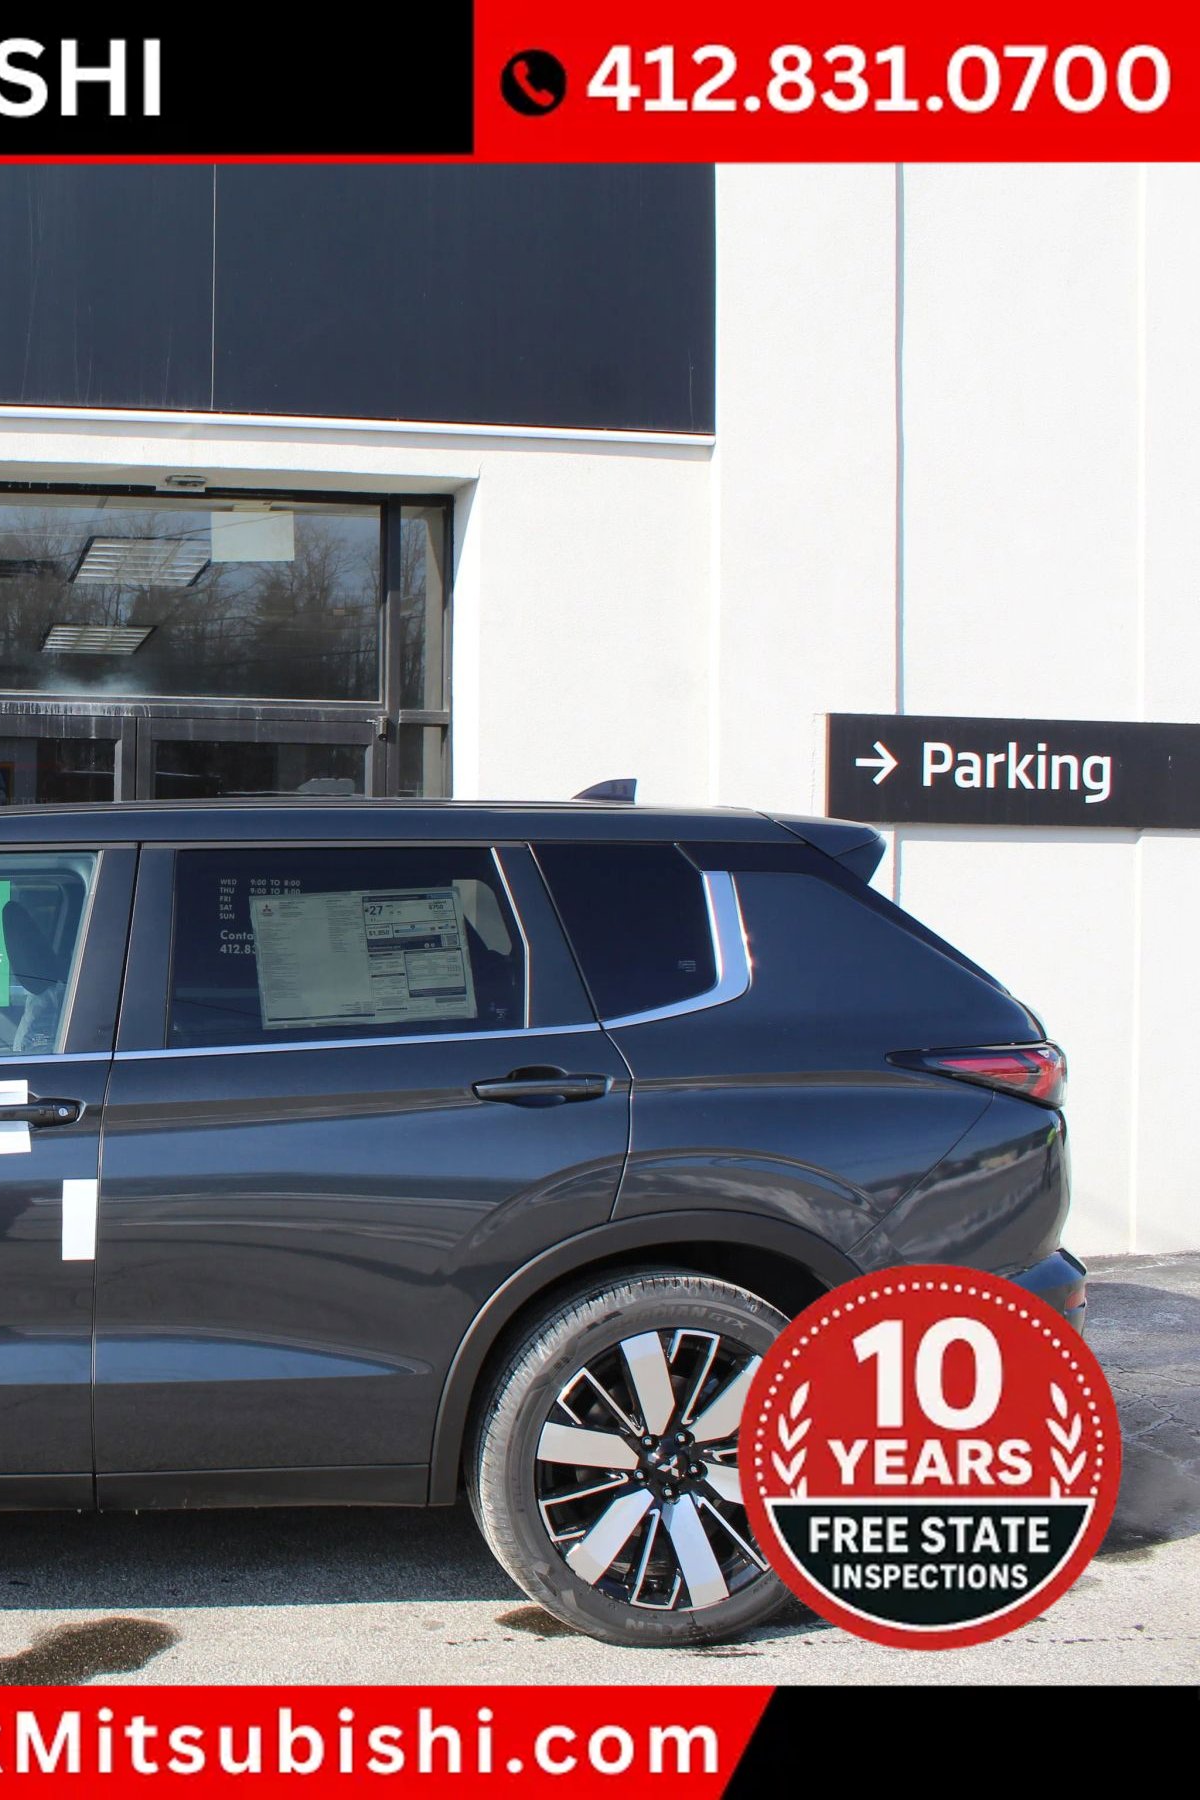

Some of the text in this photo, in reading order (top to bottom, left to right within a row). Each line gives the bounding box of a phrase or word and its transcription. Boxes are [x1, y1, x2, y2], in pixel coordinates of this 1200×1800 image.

[922, 741, 1111, 804] Parking
[220, 878, 237, 886] WED
[369, 905, 384, 916] 27
